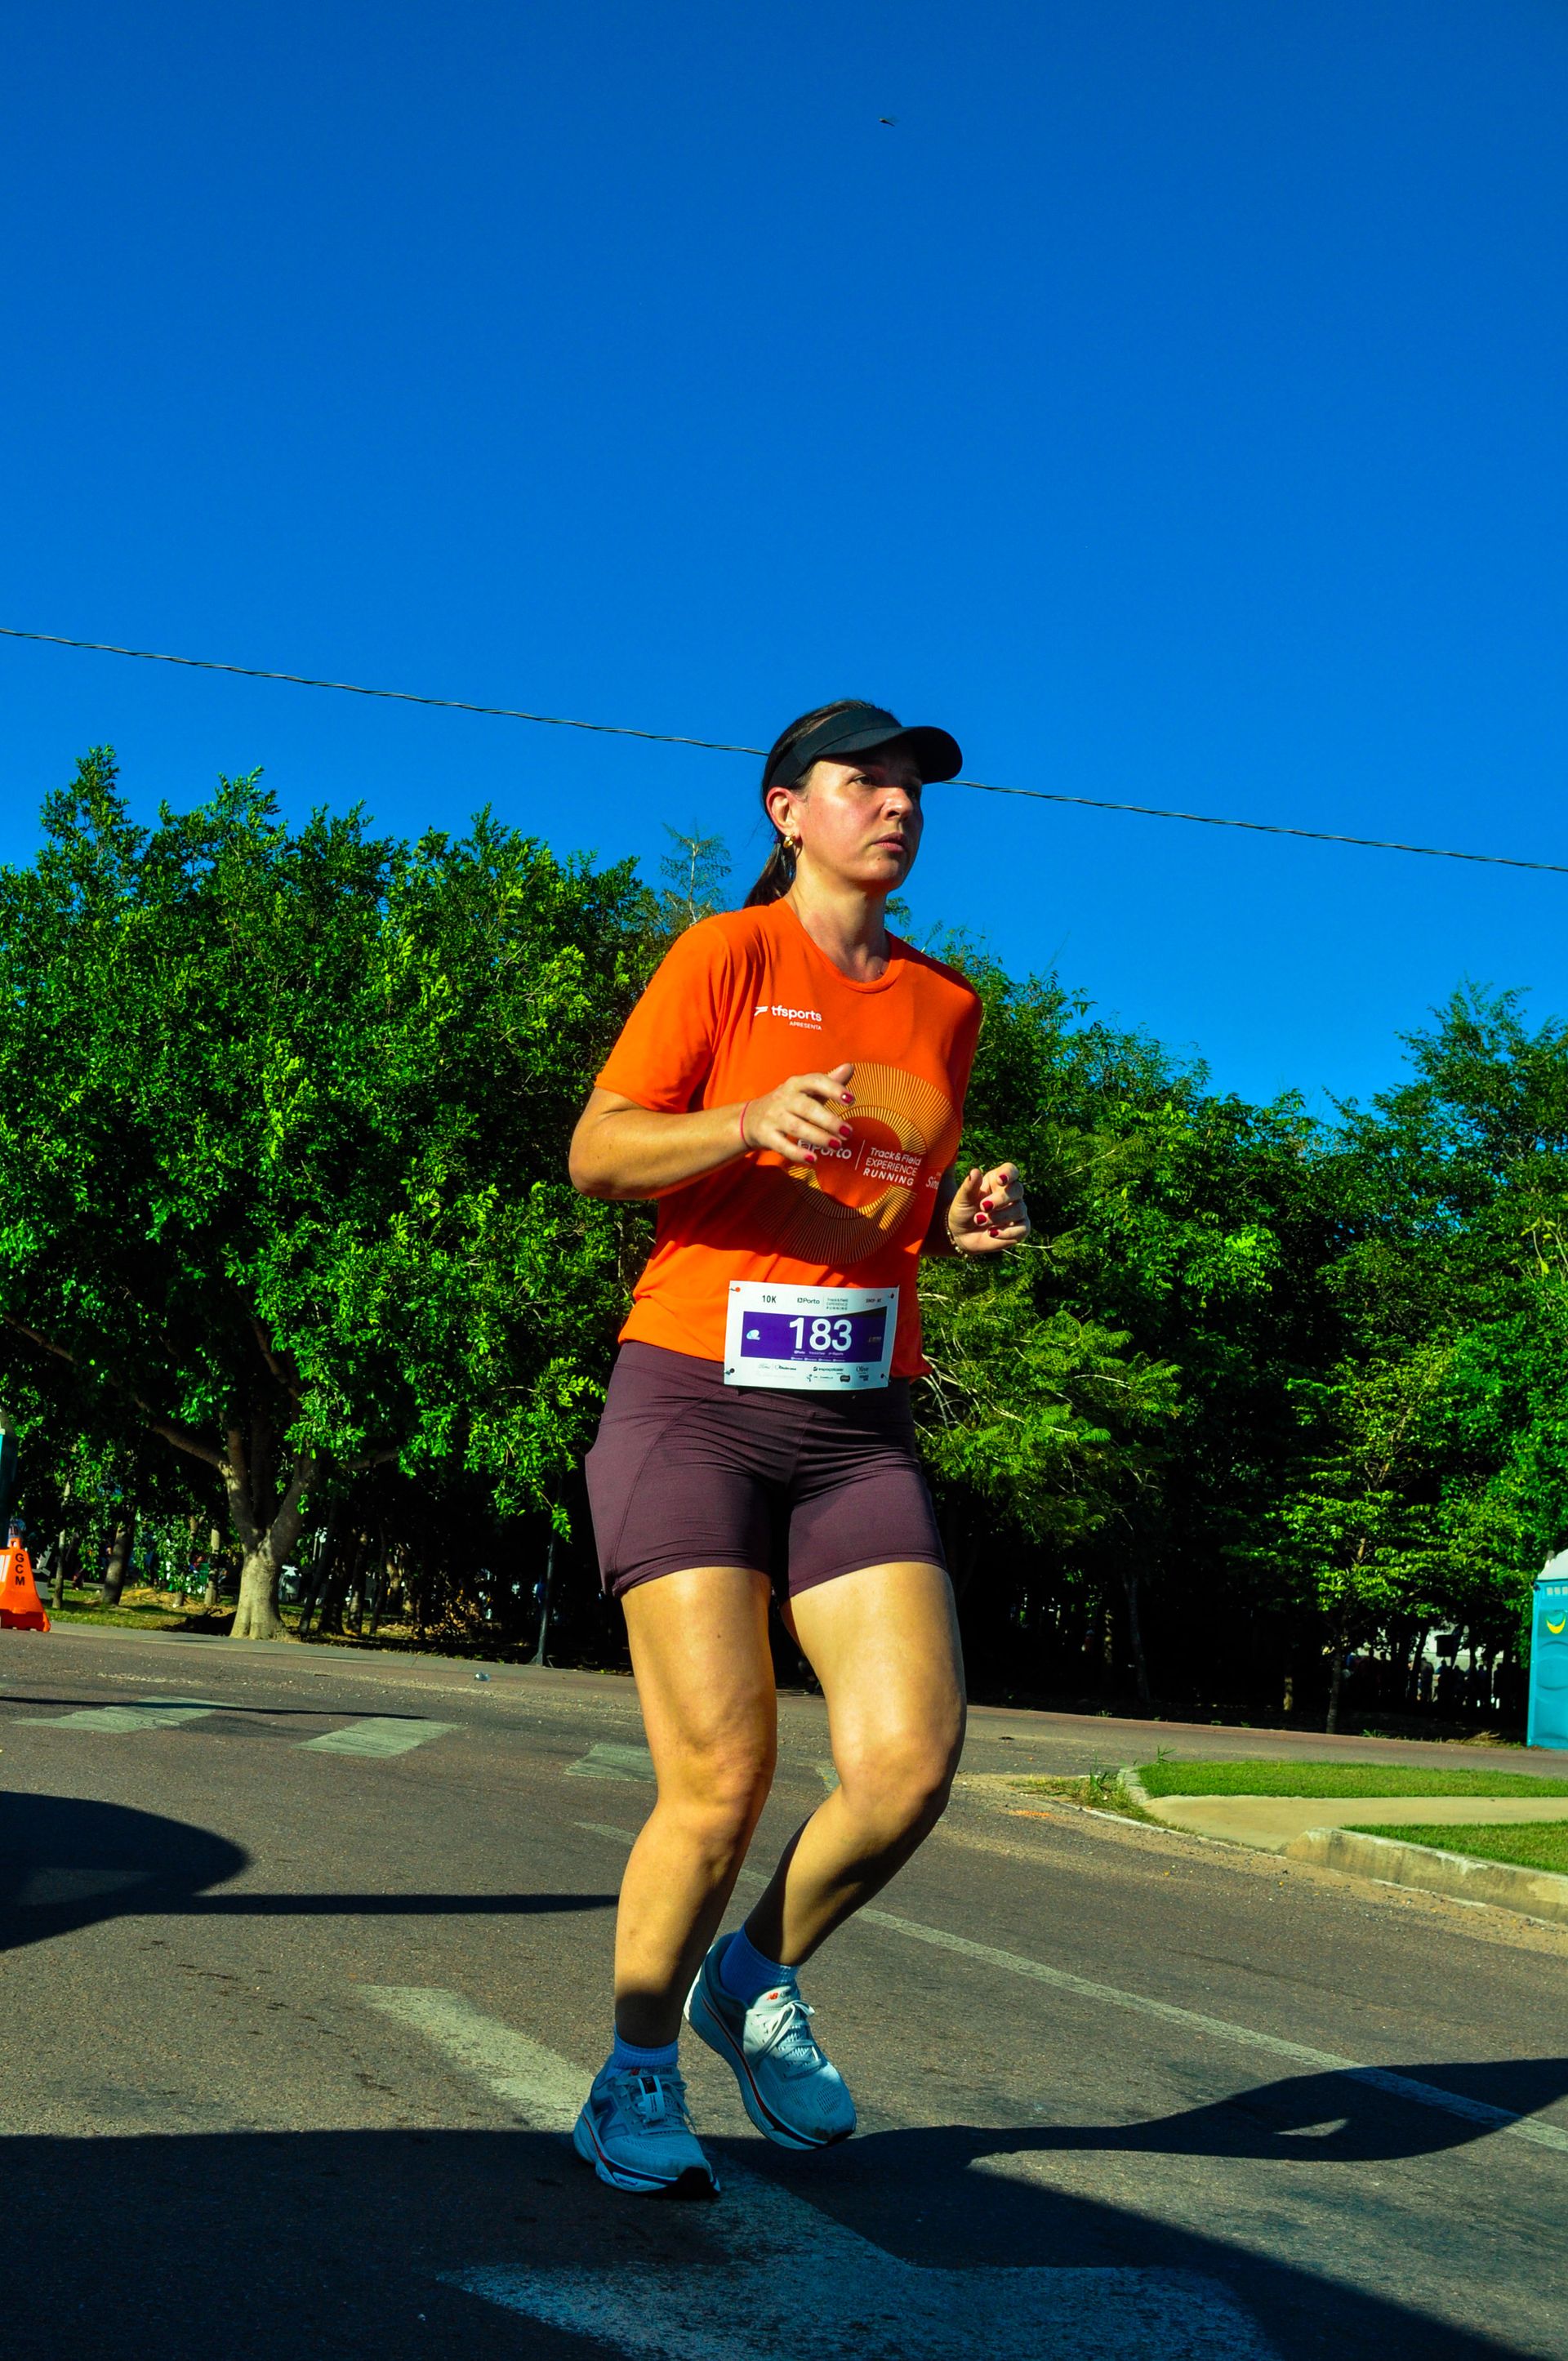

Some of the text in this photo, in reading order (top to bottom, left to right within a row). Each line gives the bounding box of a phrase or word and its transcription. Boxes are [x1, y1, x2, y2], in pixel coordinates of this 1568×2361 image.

[771, 1005, 822, 1022] tfsports
[789, 1021, 822, 1031] APRESENTA
[866, 1157, 918, 1177] EXPERIENCE
[862, 1167, 914, 1187] RUNNING
[762, 1294, 777, 1303] 10K
[789, 1316, 852, 1352] 183
